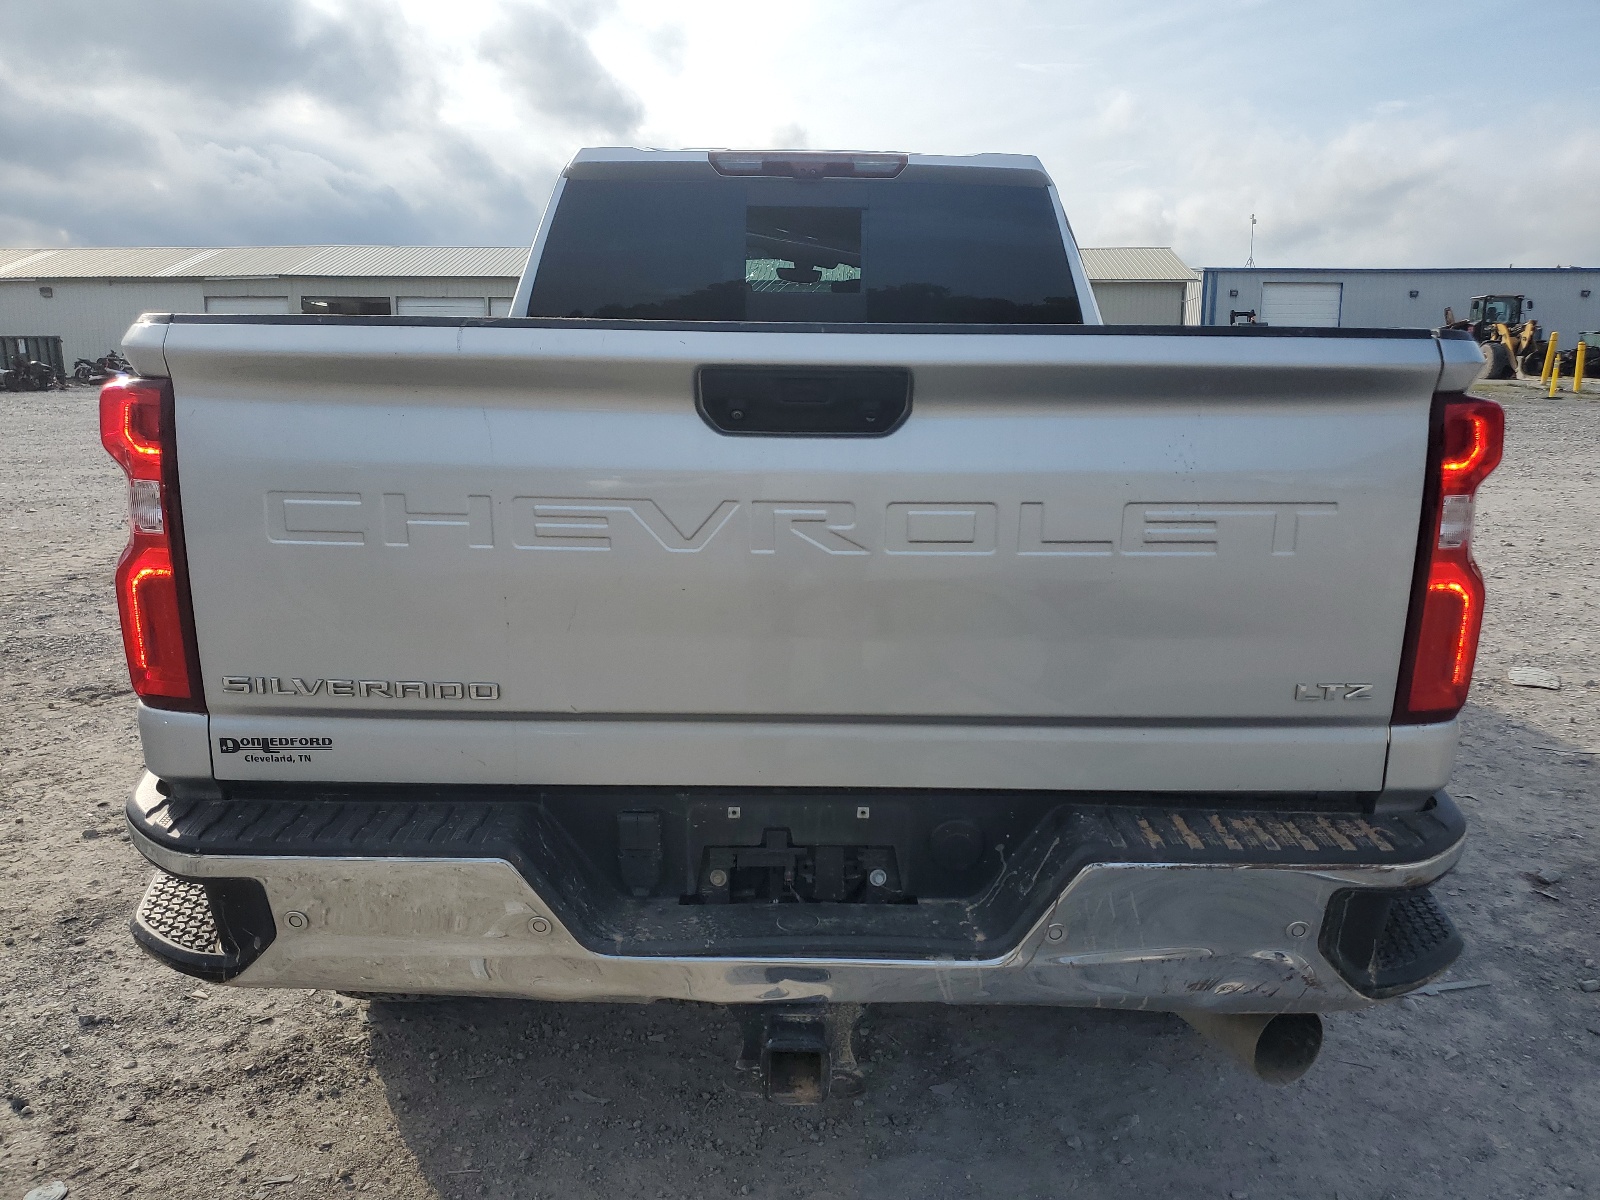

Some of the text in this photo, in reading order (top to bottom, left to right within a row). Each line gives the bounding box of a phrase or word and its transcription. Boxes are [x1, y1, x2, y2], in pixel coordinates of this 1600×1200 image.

[264, 490, 1338, 557] CHEVROLET
[222, 675, 500, 700] SILVERADO
[1294, 682, 1373, 701] LTZ
[244, 754, 312, 763] Cleveland, TN
